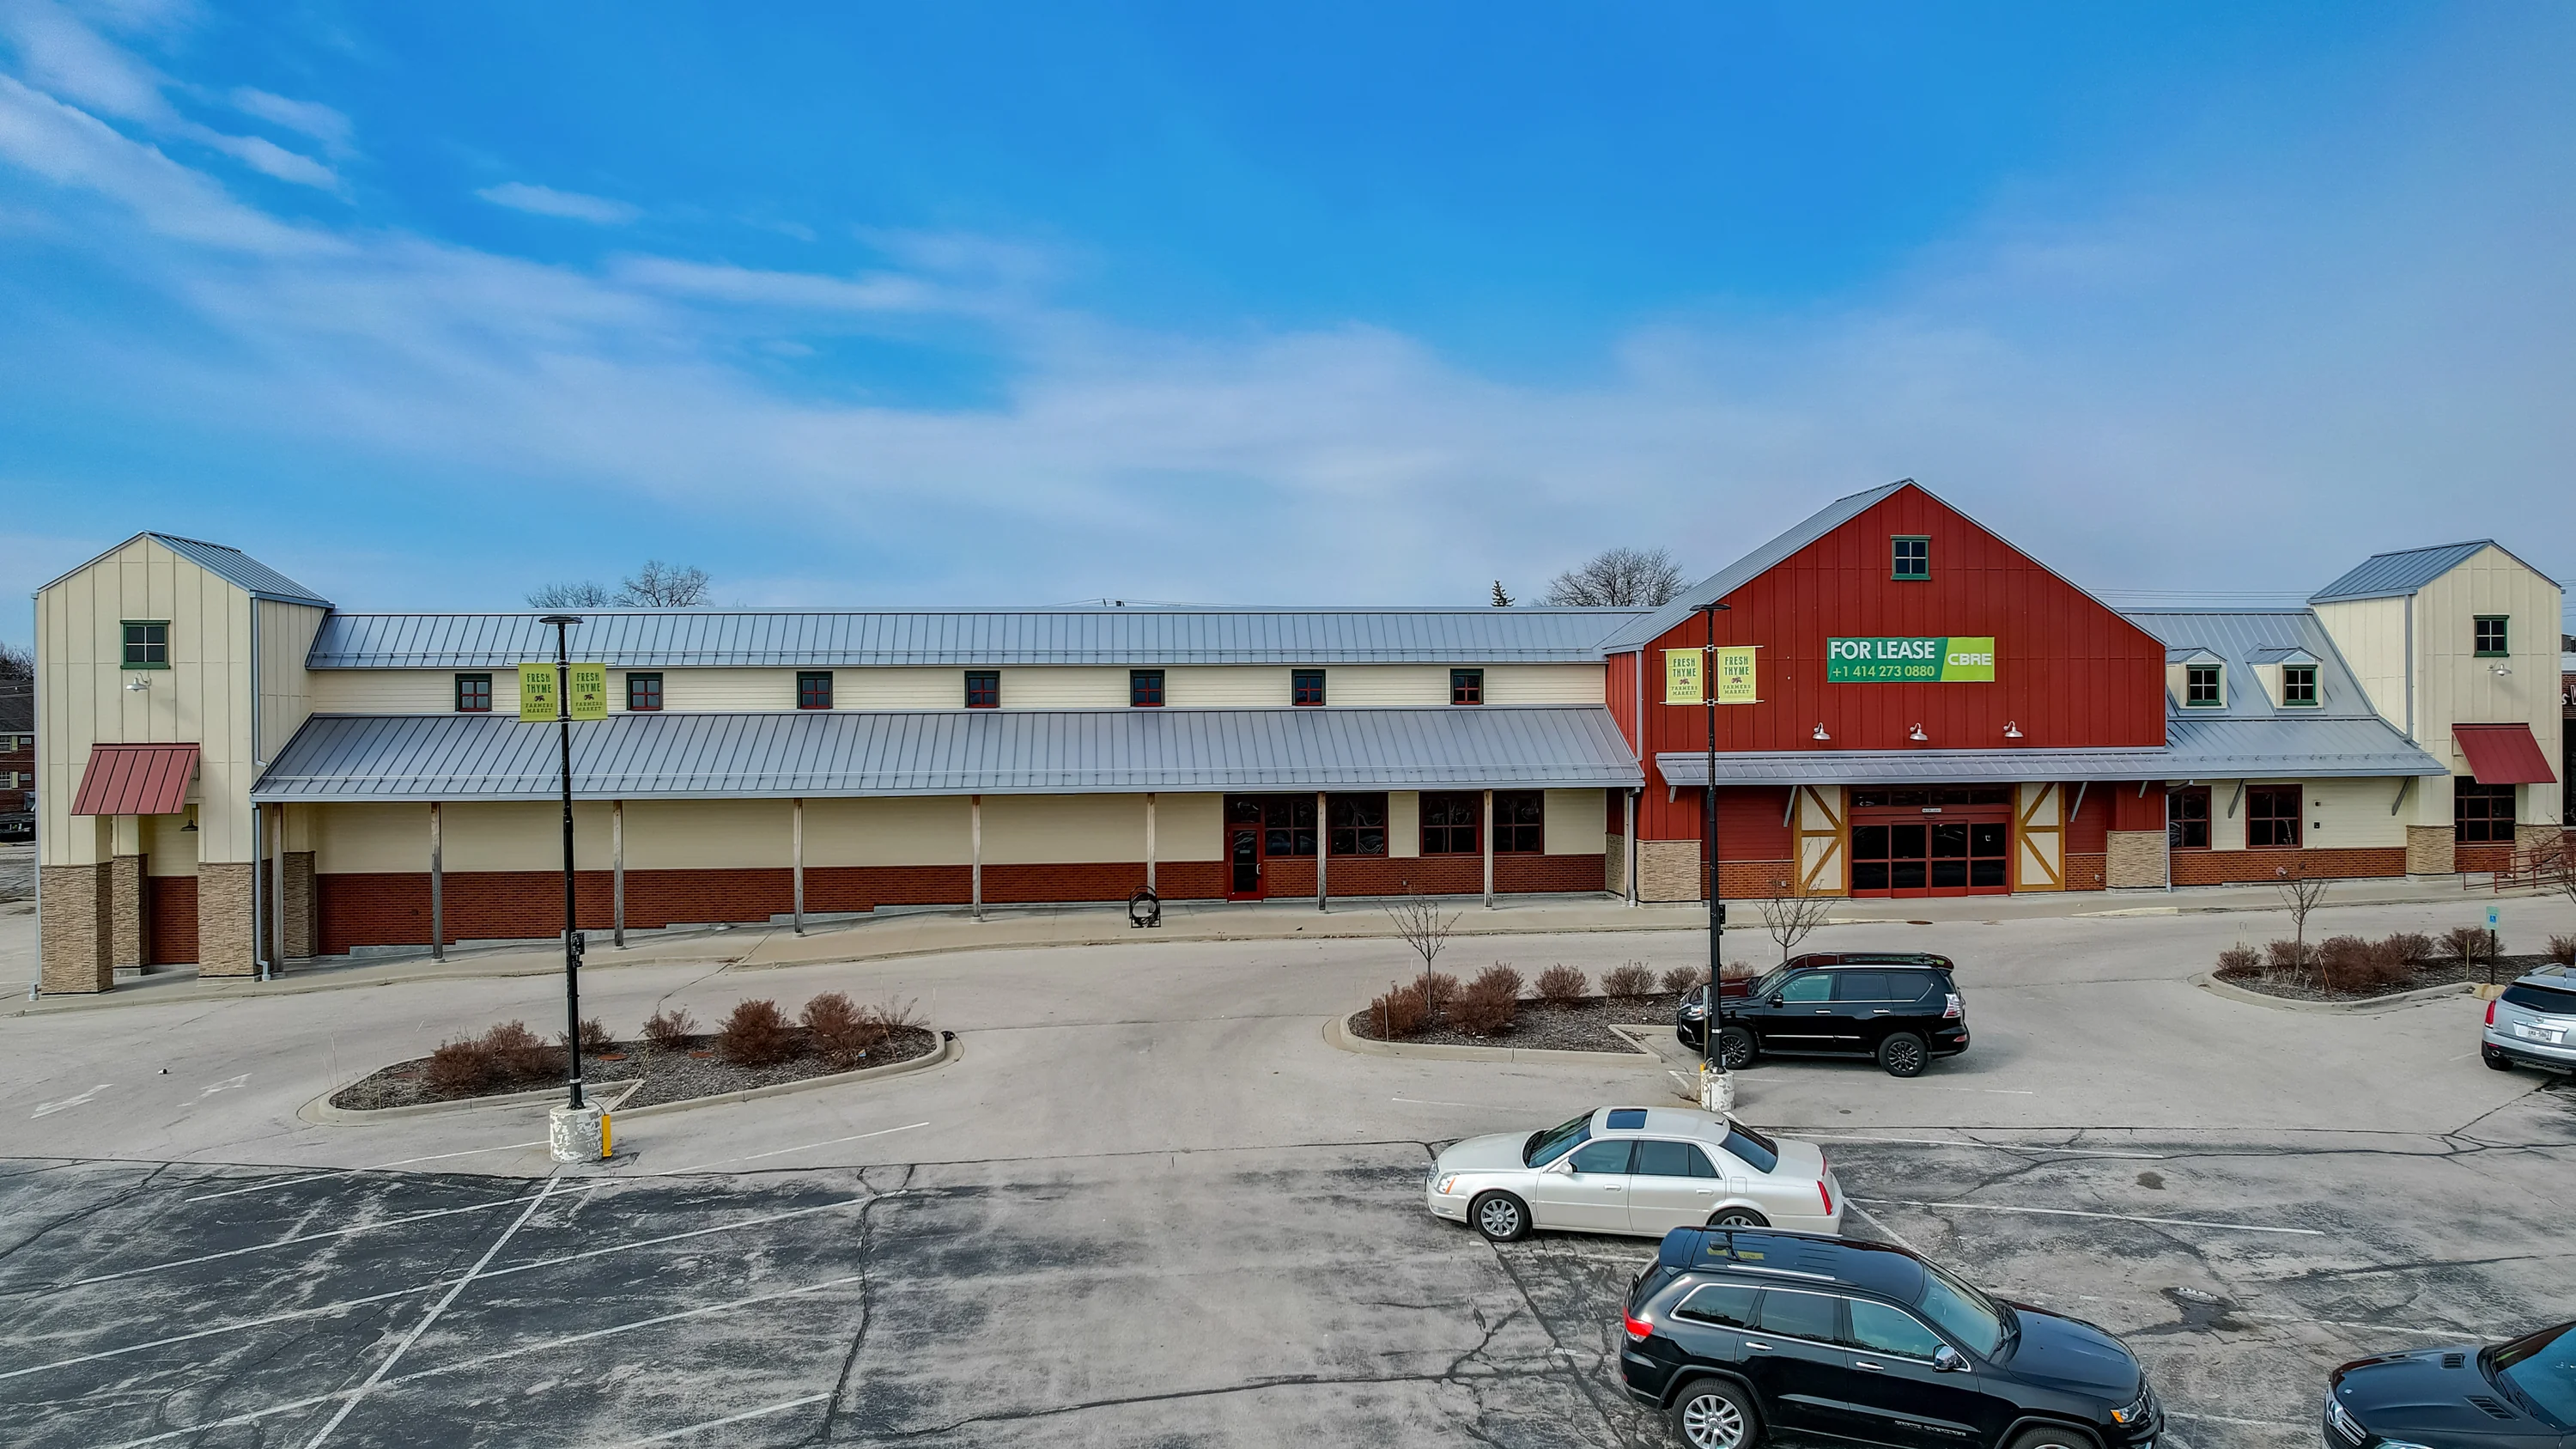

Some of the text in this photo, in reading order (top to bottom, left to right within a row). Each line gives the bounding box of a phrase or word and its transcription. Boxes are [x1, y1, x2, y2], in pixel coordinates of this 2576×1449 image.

[1830, 641, 1935, 660] FOR LEASE
[1673, 658, 1696, 667] FRESH
[1725, 656, 1748, 666] FRESH
[1947, 653, 1992, 666] CBRE
[1673, 668, 1696, 677] THYME
[1724, 667, 1749, 676] THYME
[1832, 666, 1935, 677] +1 414 273 0880
[526, 673, 550, 682] FRESH
[576, 673, 599, 681] FRESH
[526, 685, 551, 693] THYME
[576, 683, 601, 692] THYME
